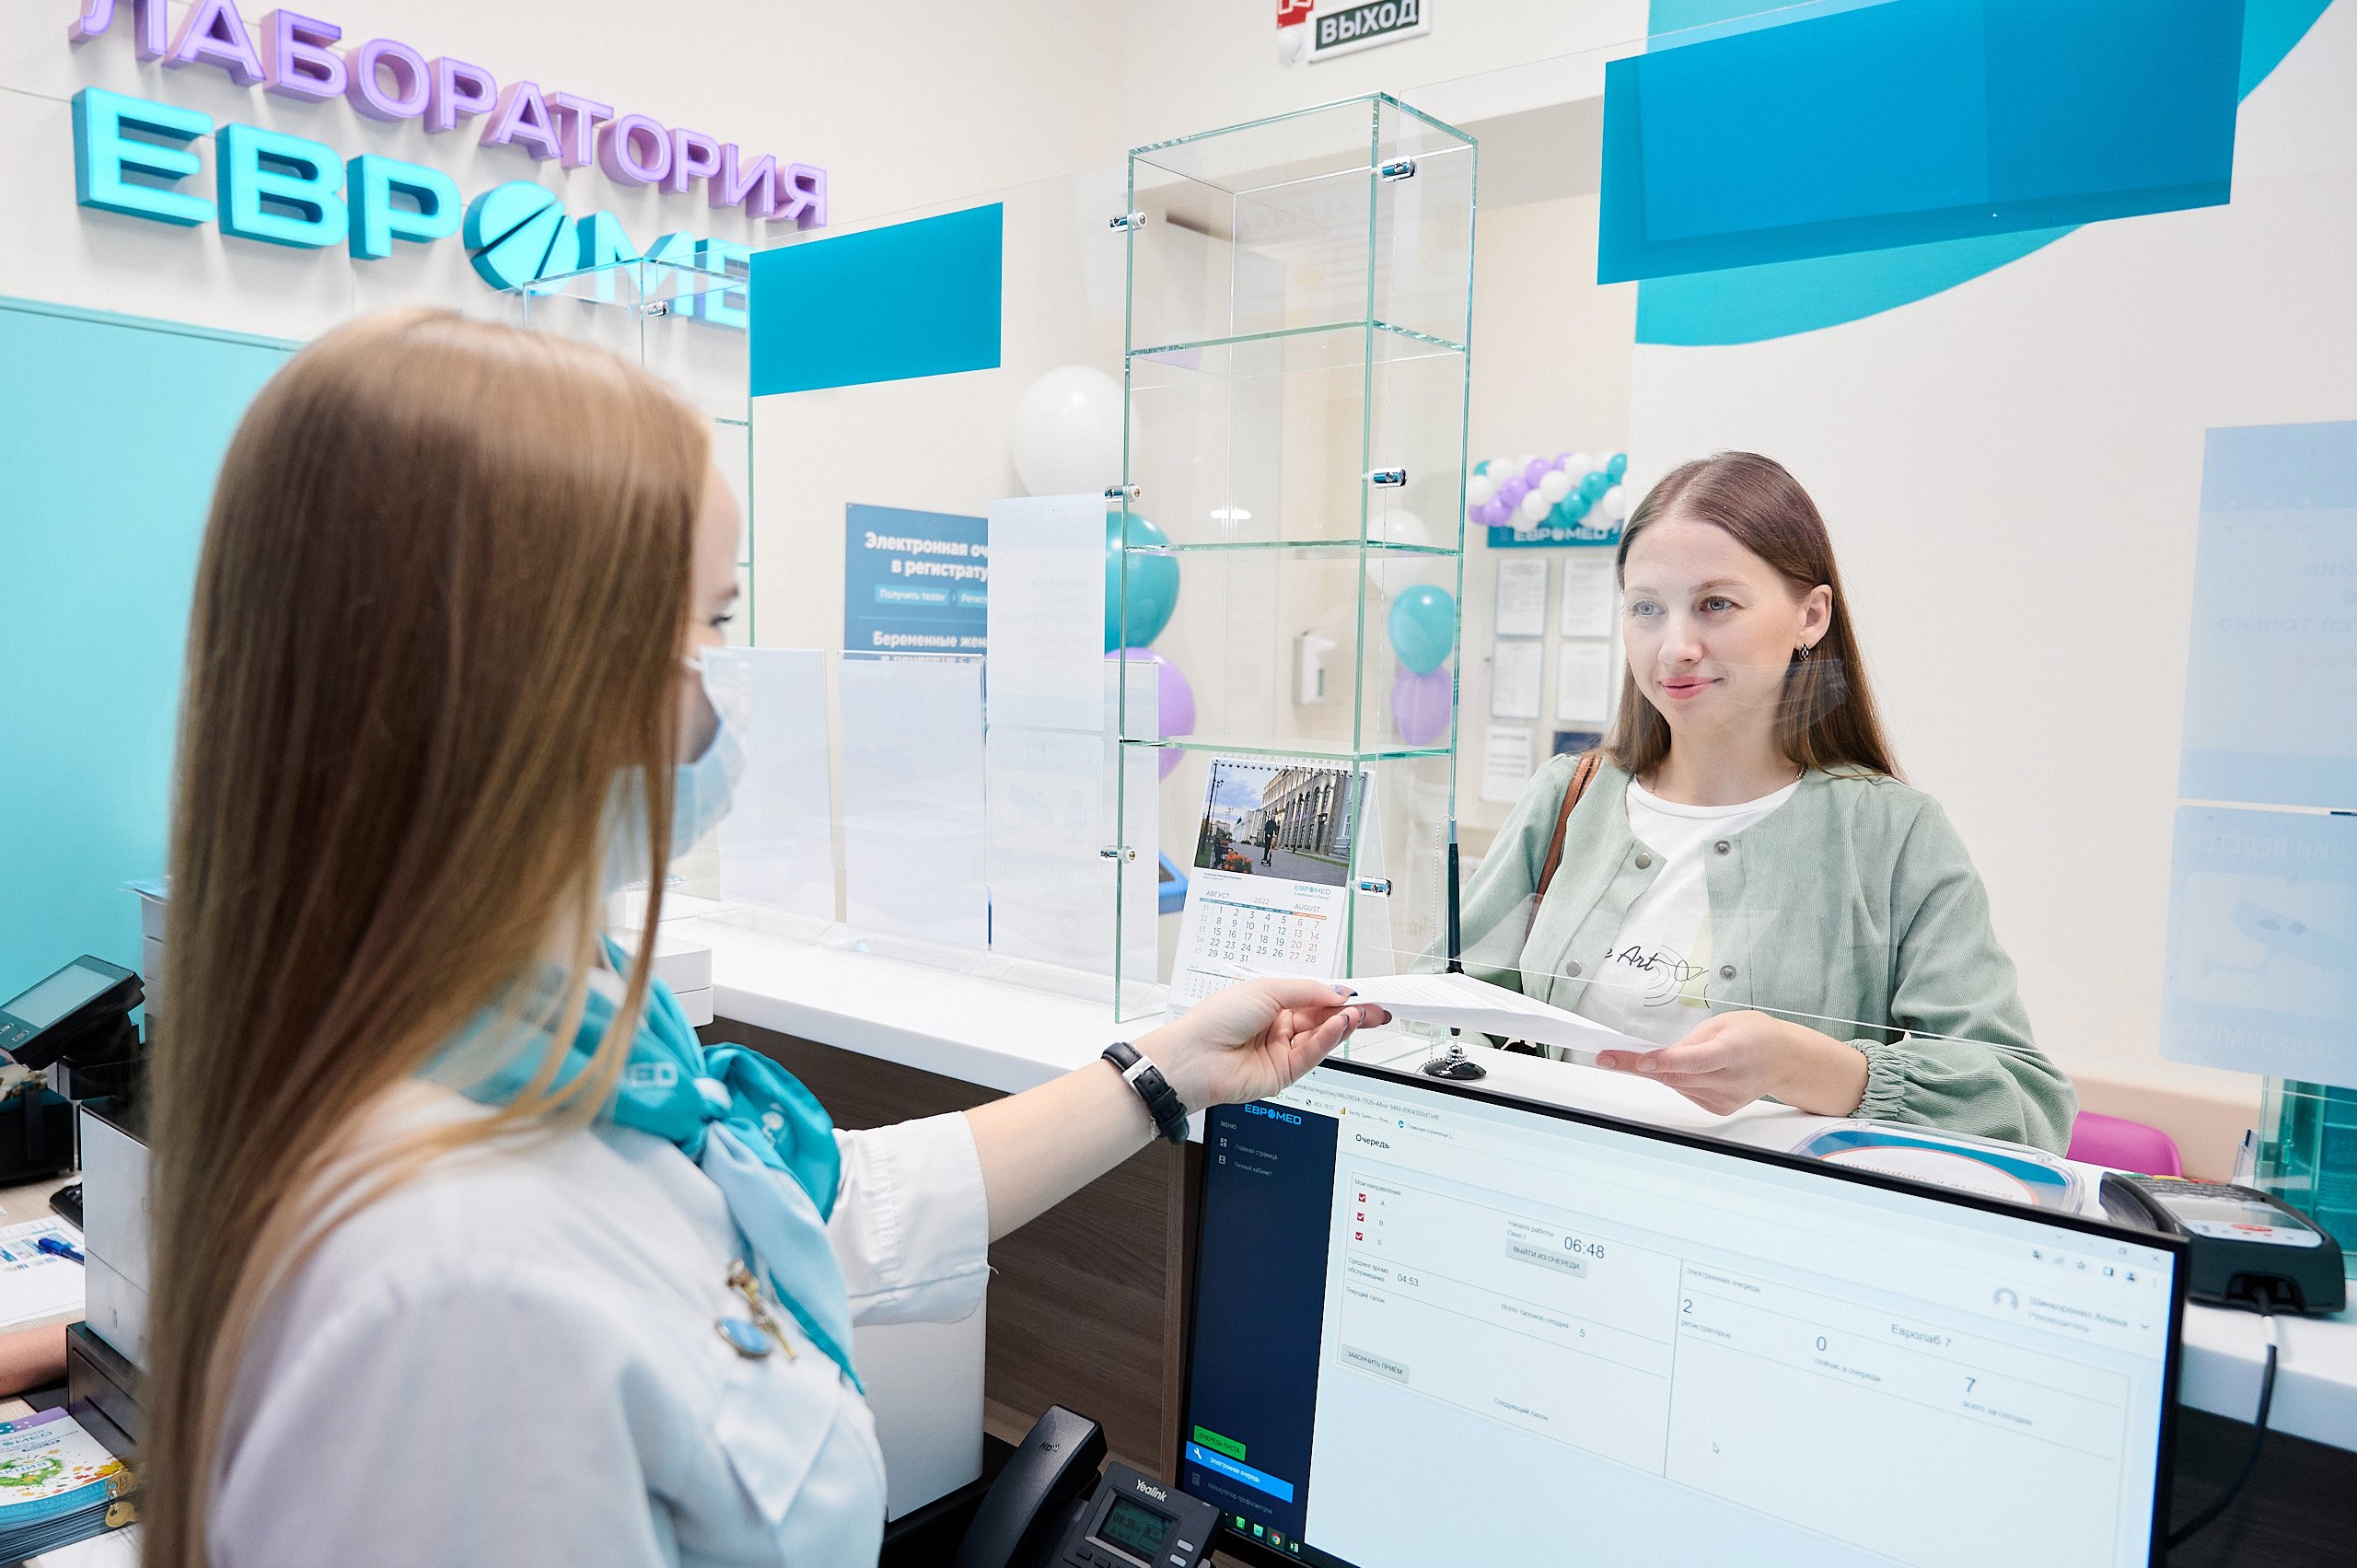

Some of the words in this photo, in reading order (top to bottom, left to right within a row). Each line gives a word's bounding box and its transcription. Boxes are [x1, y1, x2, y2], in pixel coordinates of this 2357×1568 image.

[1320, 0, 1418, 44] ВЫХОД
[72, 87, 750, 328] ЕВРОМЕ
[865, 531, 969, 556] Электронная
[891, 559, 901, 573] в
[905, 560, 988, 582] регистрату
[880, 588, 919, 602] Получить
[873, 631, 958, 648] Беременные
[1206, 889, 1230, 900] АВГУСТ
[1253, 897, 1270, 906] 2022
[1294, 903, 1321, 913] AUGUST
[1229, 930, 1237, 938] 16
[1246, 922, 1254, 930] 10
[1295, 929, 1303, 937] 13
[1311, 932, 1318, 940] 14
[1210, 938, 1220, 947] 22
[1306, 955, 1317, 963] 28
[1240, 954, 1248, 962] 31
[1617, 946, 1659, 971] Art
[1220, 1121, 1237, 1130] МЕНЮ
[1355, 1133, 1390, 1150] Очередь
[1236, 1144, 1255, 1155] Главная
[1255, 1149, 1278, 1161] страница
[1354, 1179, 1366, 1187] Мои
[1366, 1182, 1401, 1196] направления
[1508, 1220, 1530, 1231] Начало
[1531, 1225, 1554, 1237] работы
[1564, 1237, 1605, 1259] 06:48
[1348, 1257, 1371, 1270] Среднее
[1372, 1264, 1388, 1274] время
[1513, 1245, 1537, 1259] ВЫЙТИ
[1538, 1253, 1547, 1261] ИЗ
[1547, 1255, 1580, 1270] ОЧЕРЕДИ
[1347, 1266, 1386, 1283] обслуживания
[1397, 1273, 1419, 1287] 04:53
[1686, 1267, 1730, 1285] Электронная
[1732, 1279, 1761, 1293] очередь
[1346, 1286, 1369, 1299] Текущий
[1369, 1294, 1386, 1304] талон
[1683, 1298, 1693, 1314] 2
[1502, 1303, 1518, 1314] Всего
[1519, 1308, 1544, 1321] талонов
[1545, 1316, 1570, 1329] сегодня
[1579, 1329, 1585, 1338] 5
[1681, 1319, 1731, 1338] регистраторов
[1944, 1338, 1952, 1348] 7
[1347, 1350, 1381, 1367] ЗАКОНЧИТЬ
[1814, 1356, 1840, 1371] сейчас
[1848, 1367, 1881, 1382] очереди
[1966, 1376, 1976, 1393] 7
[1493, 1398, 1529, 1415] Следующий
[1531, 1410, 1549, 1422] талон
[1199, 1433, 1223, 1446] ОЧЕРЕДЬ
[1224, 1443, 1240, 1454] ПУСТА
[1209, 1457, 1240, 1475] Электронная
[1240, 1469, 1260, 1483] очередь
[1136, 1479, 1168, 1502] Yealink
